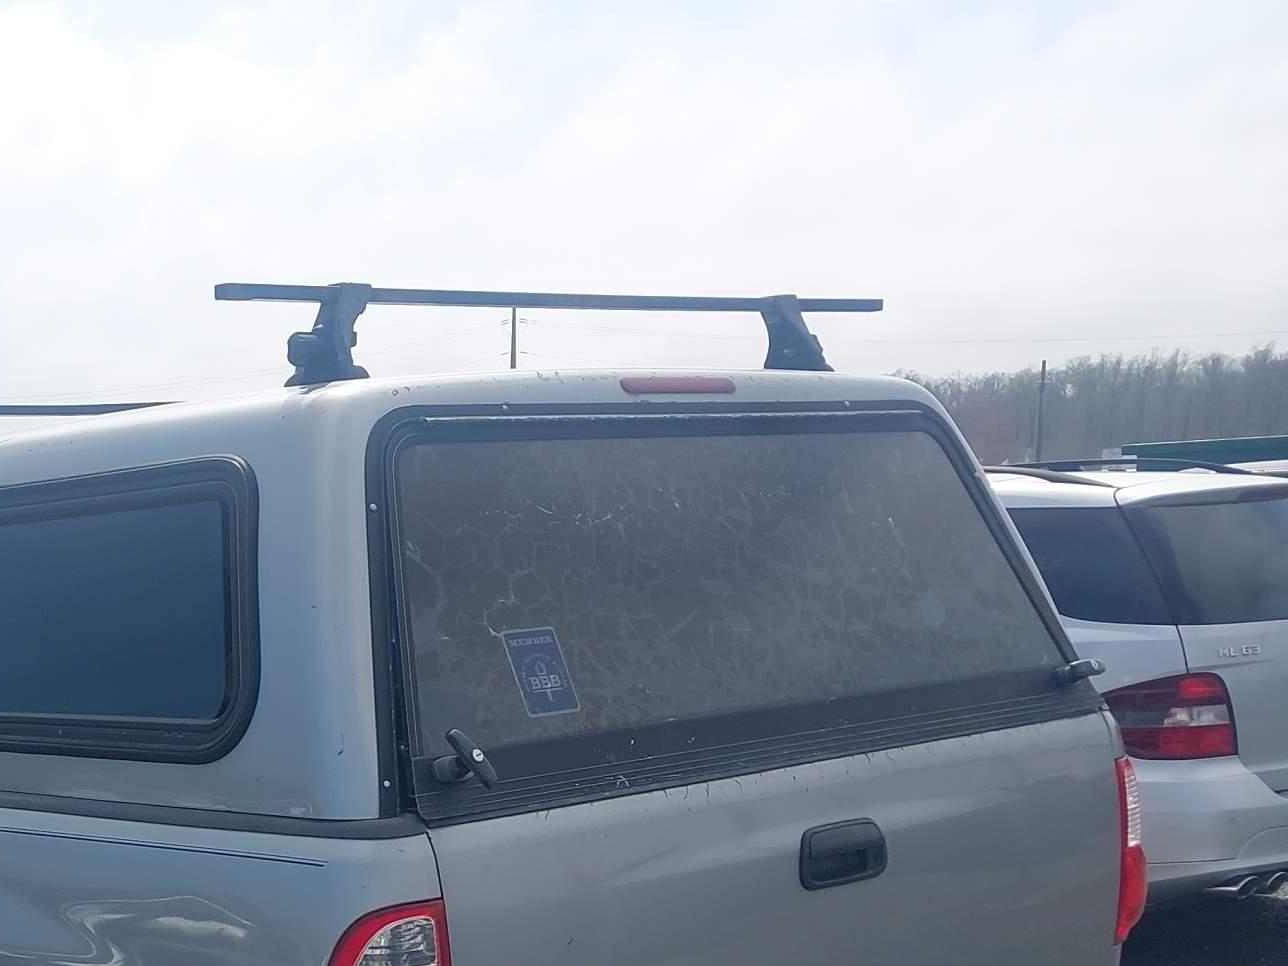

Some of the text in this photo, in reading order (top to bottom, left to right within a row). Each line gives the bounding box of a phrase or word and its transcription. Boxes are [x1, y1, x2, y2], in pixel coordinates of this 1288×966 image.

[509, 635, 553, 647] MEMBER
[1218, 647, 1239, 657] ML
[528, 674, 561, 690] BBB
